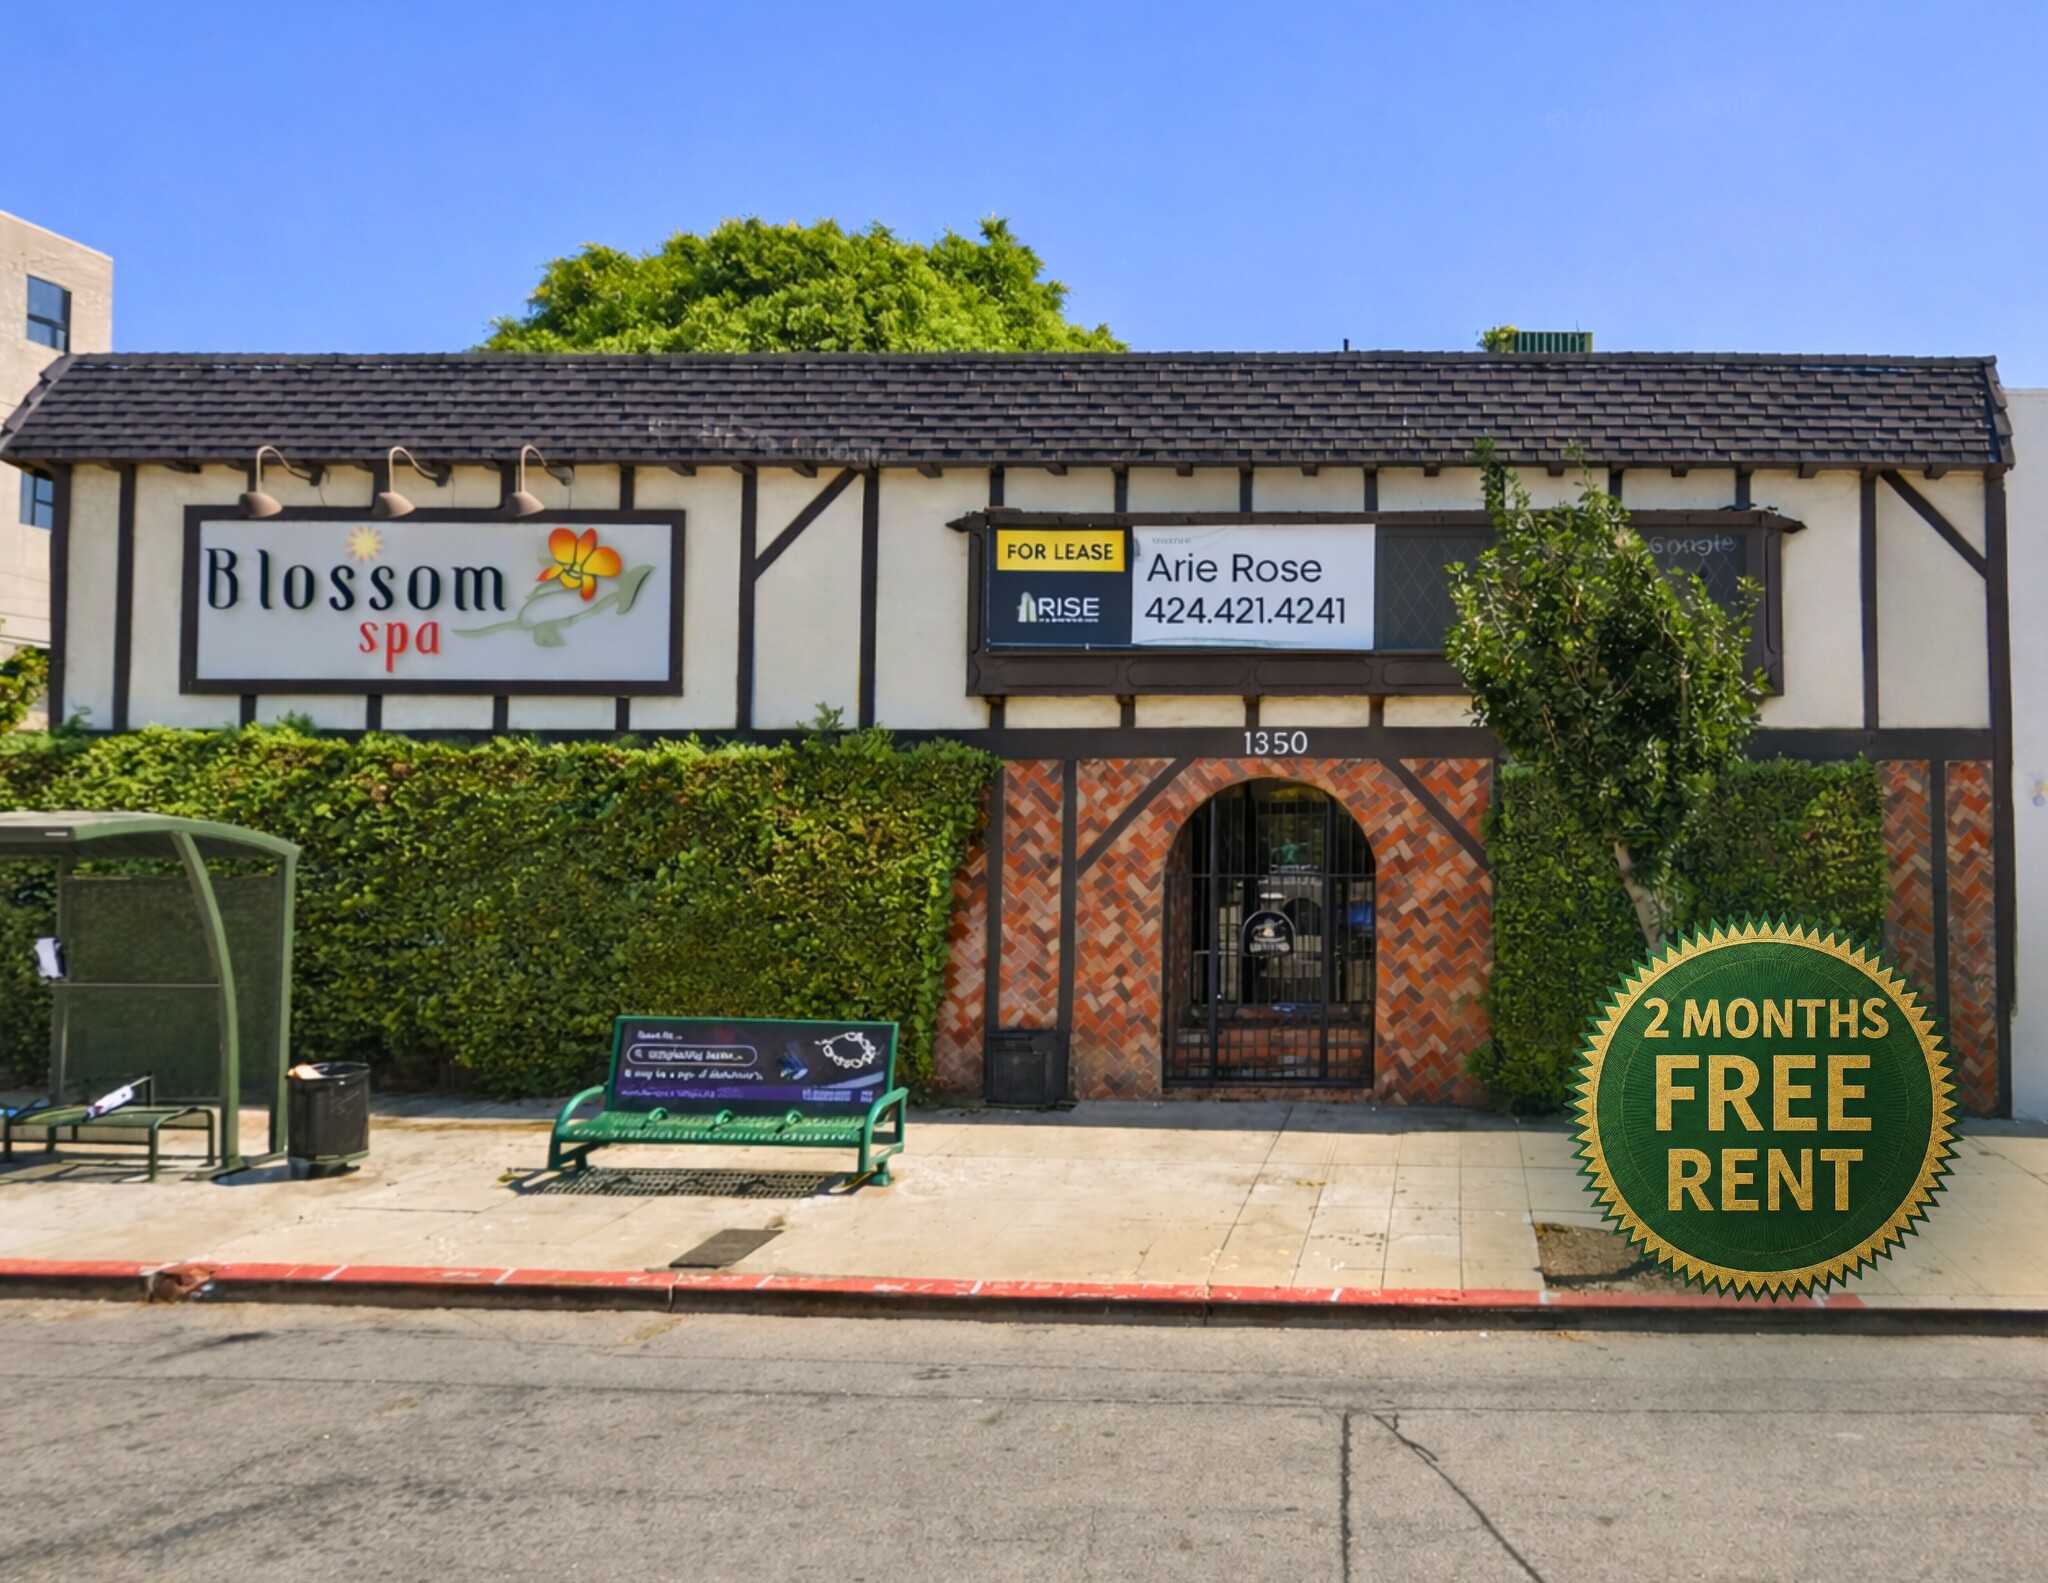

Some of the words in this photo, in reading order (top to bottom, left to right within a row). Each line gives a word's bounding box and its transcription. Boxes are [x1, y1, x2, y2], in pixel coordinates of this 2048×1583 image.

[1007, 544, 1047, 560] FOR
[1054, 544, 1114, 561] LEASE
[205, 548, 506, 612] Blossom
[1147, 553, 1218, 583] Arie
[1232, 554, 1323, 583] Rose
[1038, 597, 1100, 617] RISE
[1145, 597, 1345, 624] 424.421.4241
[359, 621, 440, 672] spa
[1245, 732, 1308, 755] 1350
